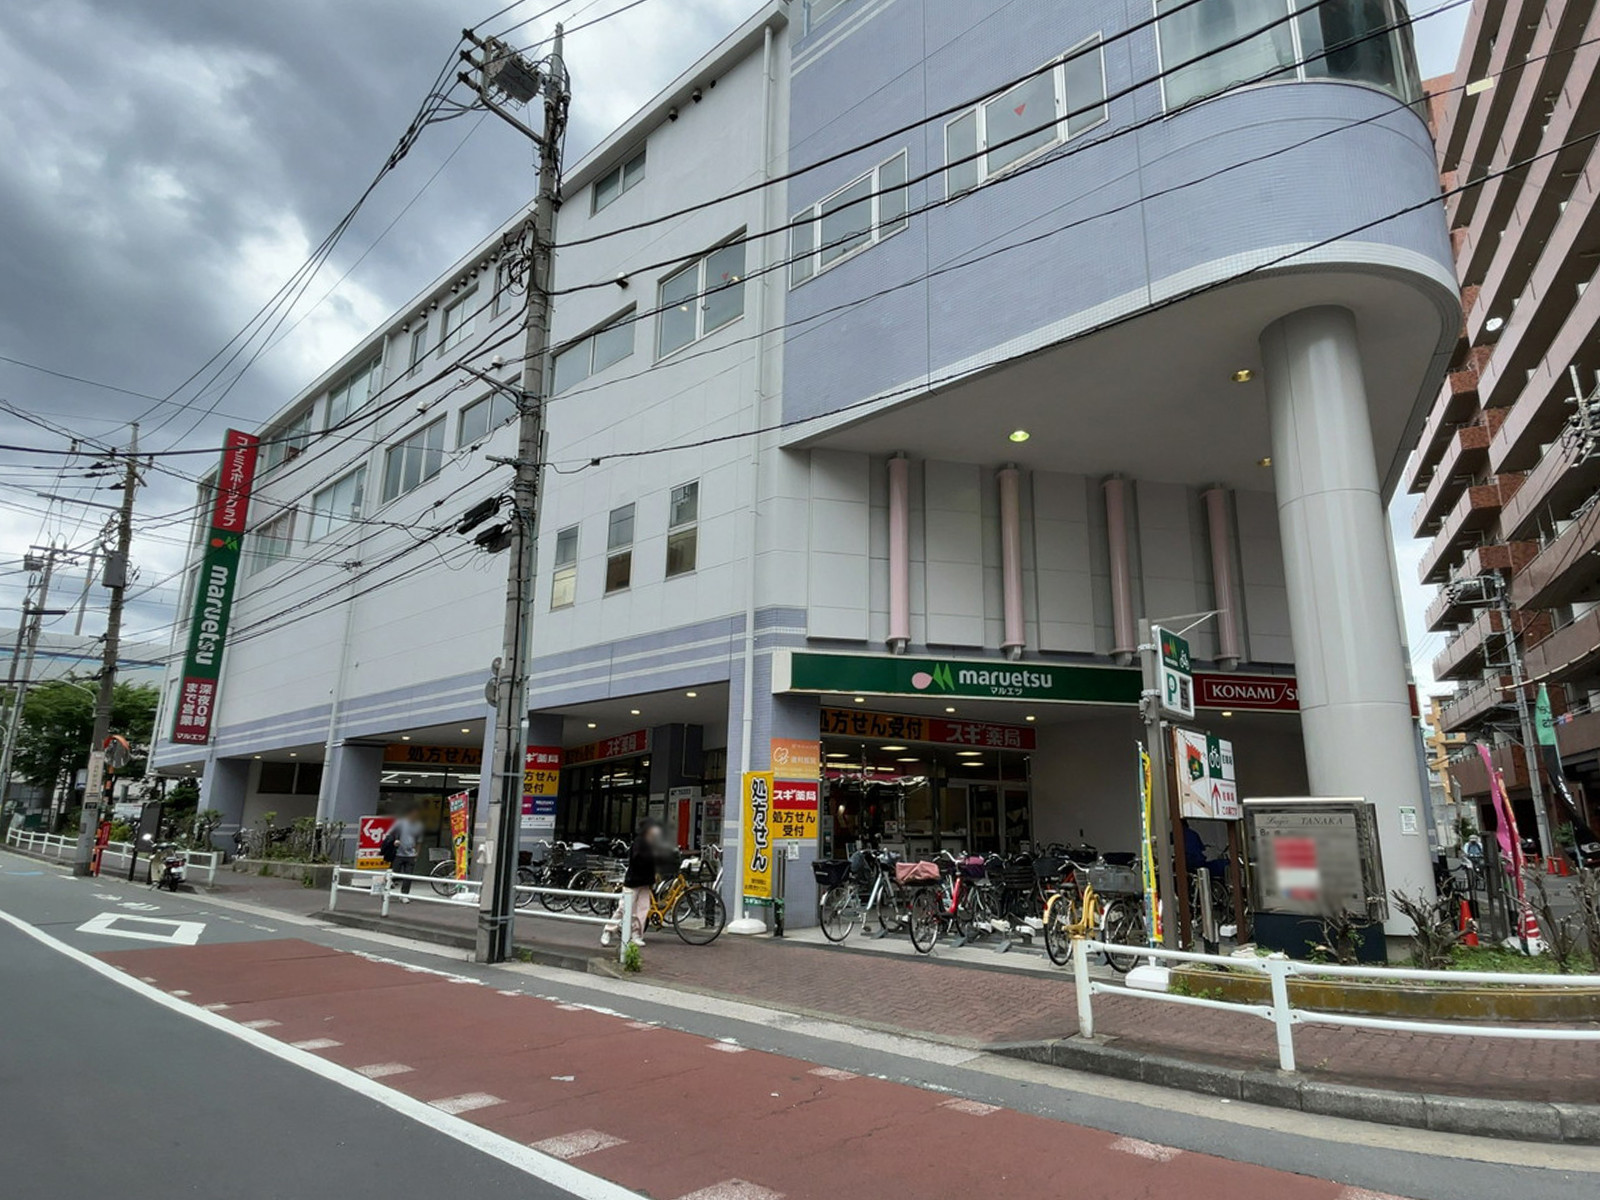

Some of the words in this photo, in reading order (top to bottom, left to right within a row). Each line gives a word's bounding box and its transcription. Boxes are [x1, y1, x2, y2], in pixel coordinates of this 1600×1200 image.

[195, 565, 229, 665] maruetsu
[959, 670, 1052, 688] maruetsu
[990, 687, 1022, 696] マルエツ
[1212, 685, 1275, 700] KONAMI
[176, 733, 206, 741] マルエツ
[946, 723, 1020, 747] スギ薬局
[408, 745, 481, 765] 処方せん
[526, 752, 559, 763] ギ薬局
[524, 771, 557, 782] 方せん
[773, 789, 816, 801] スギ薬局
[773, 811, 815, 823] 処方せん
[750, 777, 769, 873] 処方せん
[782, 825, 804, 836] 受付
